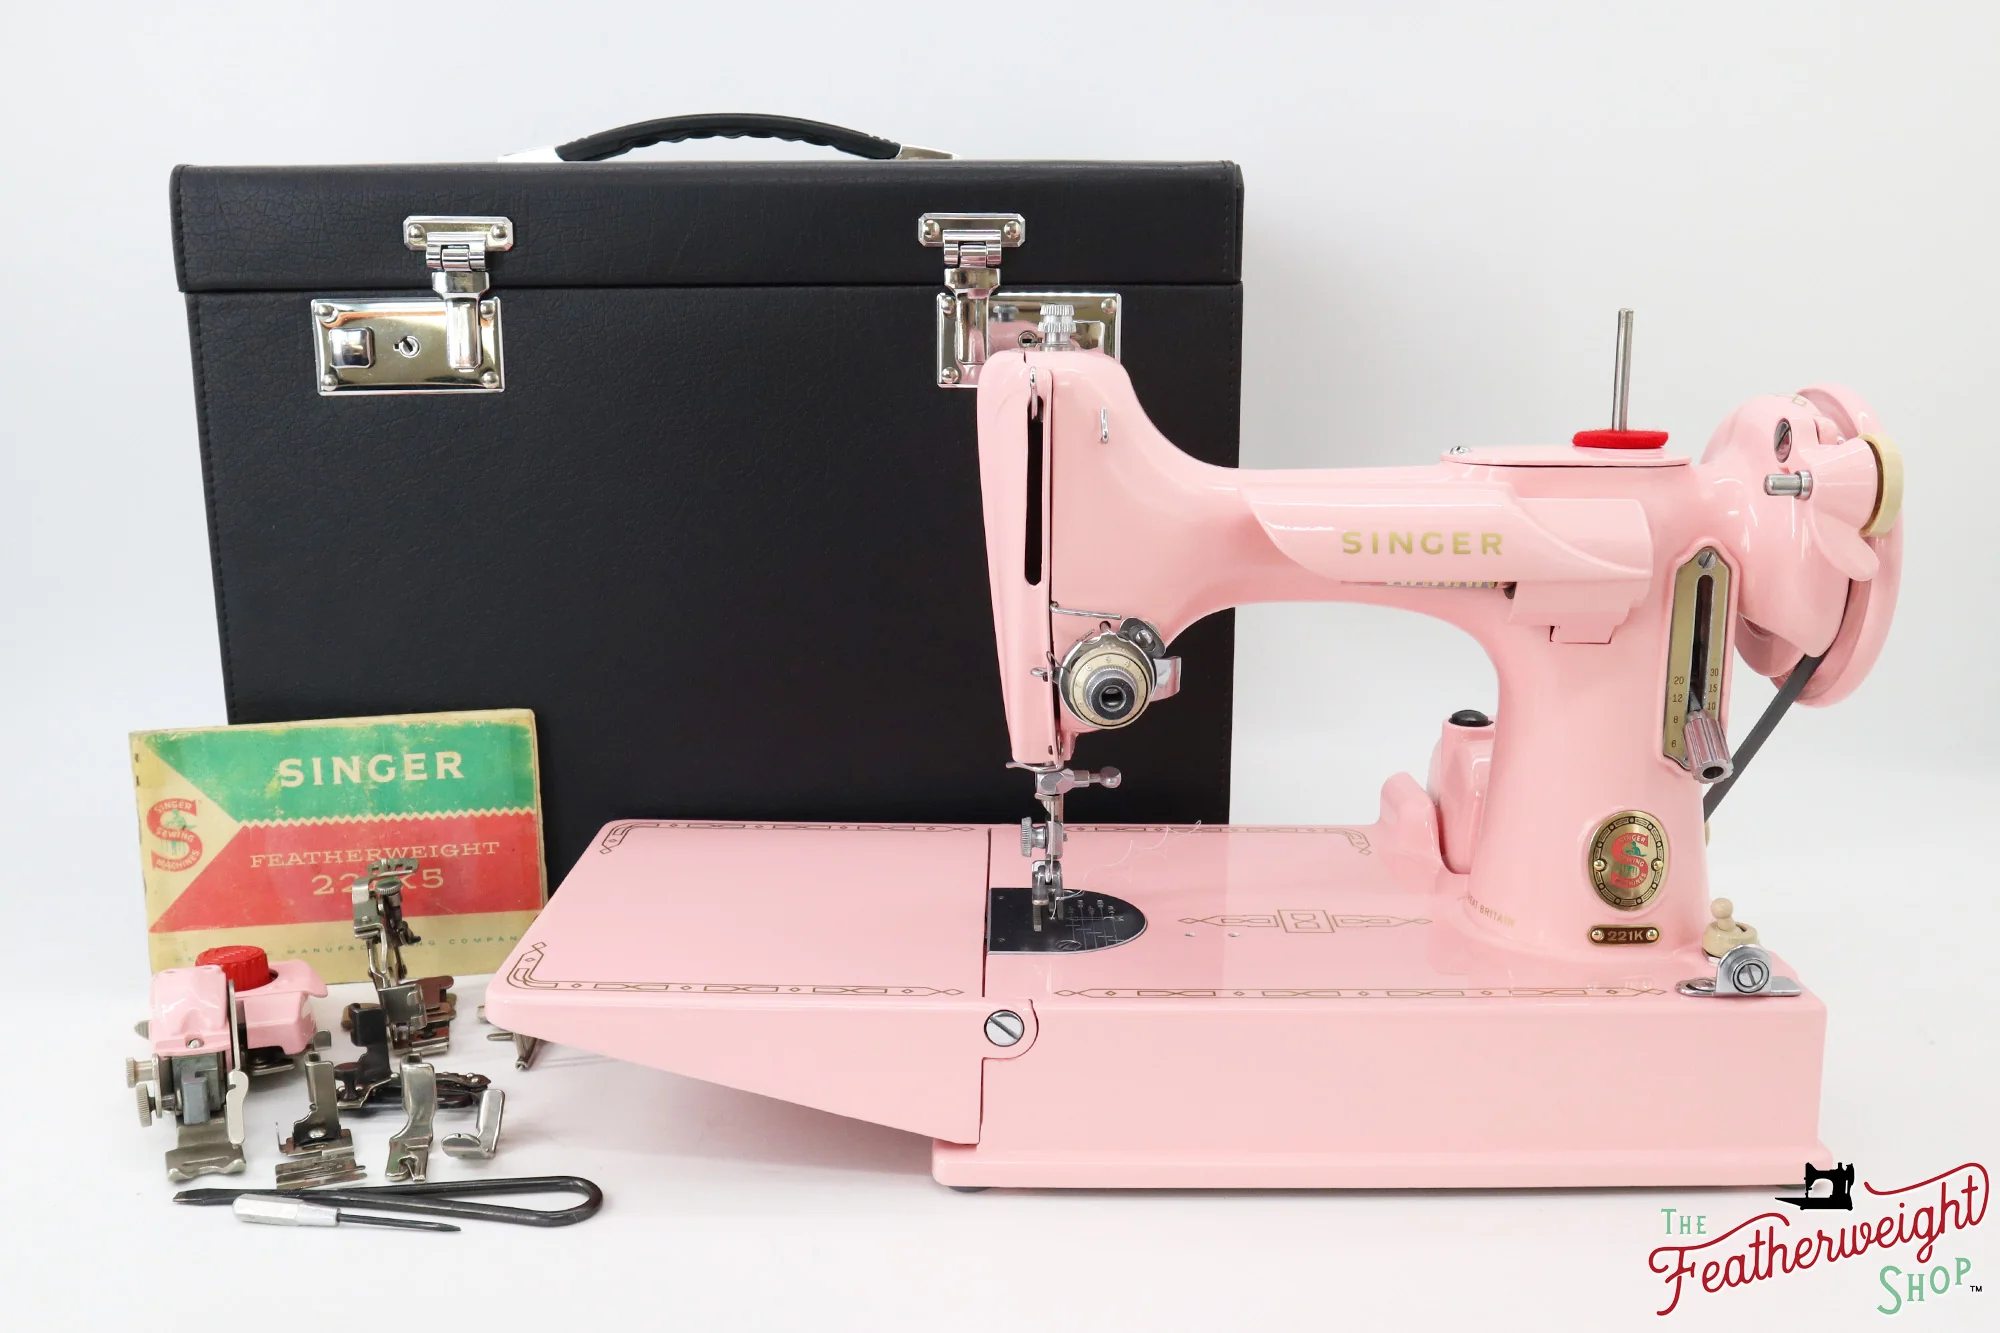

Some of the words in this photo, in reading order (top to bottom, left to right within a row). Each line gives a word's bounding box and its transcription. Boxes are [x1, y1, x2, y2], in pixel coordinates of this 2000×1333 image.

[1341, 531, 1503, 555] SINGER
[1710, 668, 1719, 676] 30
[1674, 676, 1684, 685] 20
[1709, 684, 1718, 692] 15
[1672, 694, 1683, 702] 12
[1708, 702, 1716, 710] 10
[1673, 716, 1679, 724] 8
[1671, 740, 1677, 748] 6
[279, 751, 465, 788] SINGER
[154, 801, 193, 813] SINGER
[155, 827, 195, 843] SEWING
[155, 849, 200, 869] MACHINES
[250, 841, 500, 868] FEATHERWEIGHT
[311, 868, 444, 895] 22K5
[1607, 930, 1644, 941] 221K
[286, 939, 436, 955] MANUFACNG
[448, 935, 518, 945] COMPAN
